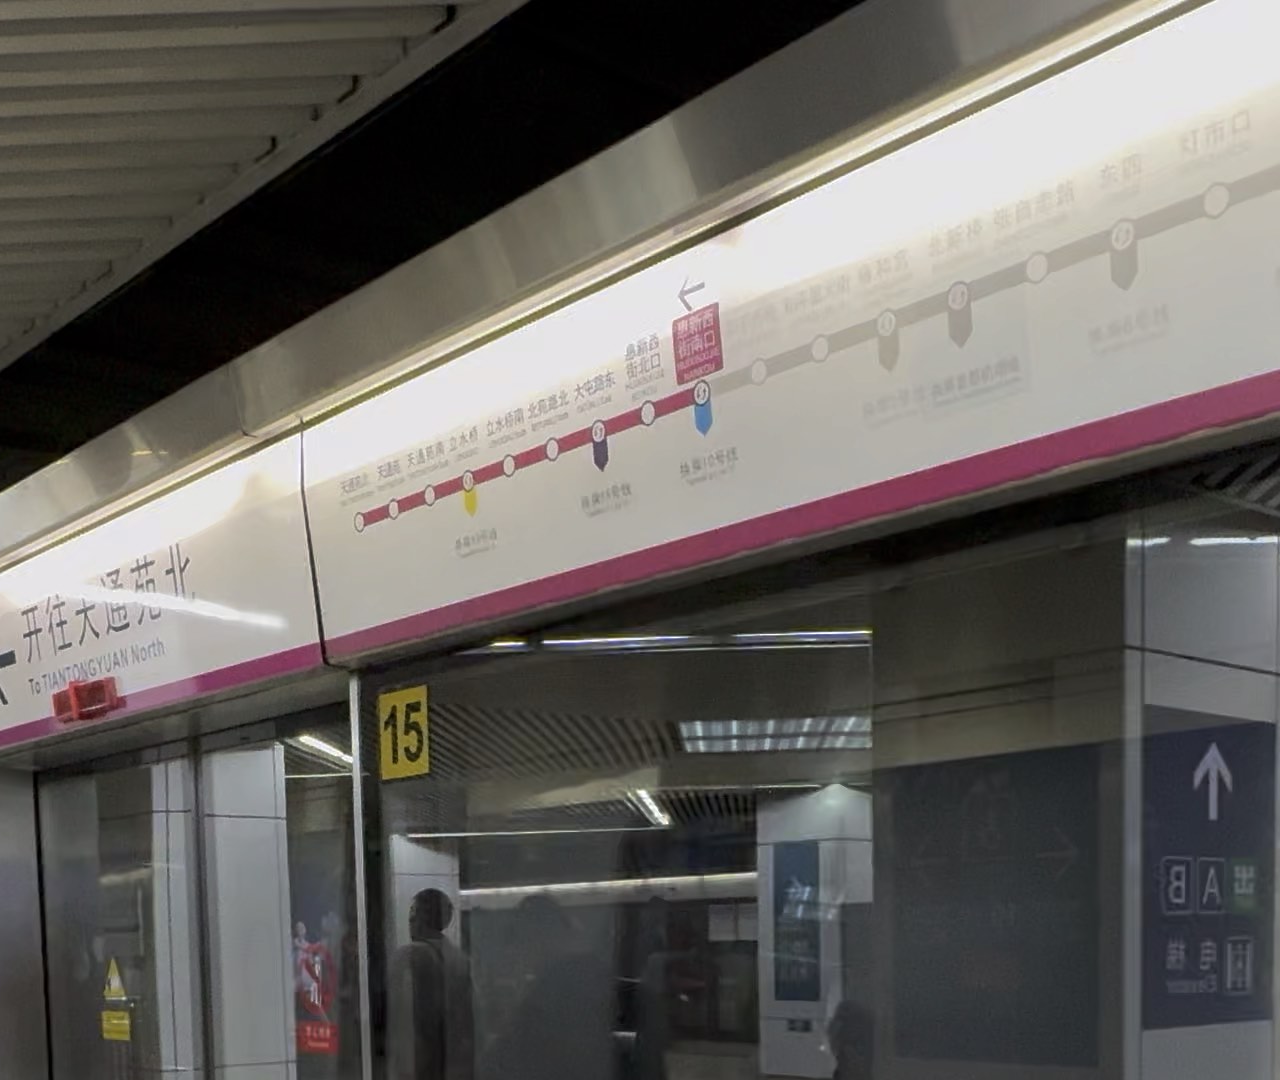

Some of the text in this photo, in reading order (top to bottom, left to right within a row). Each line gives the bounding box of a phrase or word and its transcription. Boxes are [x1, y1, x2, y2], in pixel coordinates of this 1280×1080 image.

[28, 637, 167, 696] To TIANTONGYUAN North
[384, 703, 424, 765] 15
